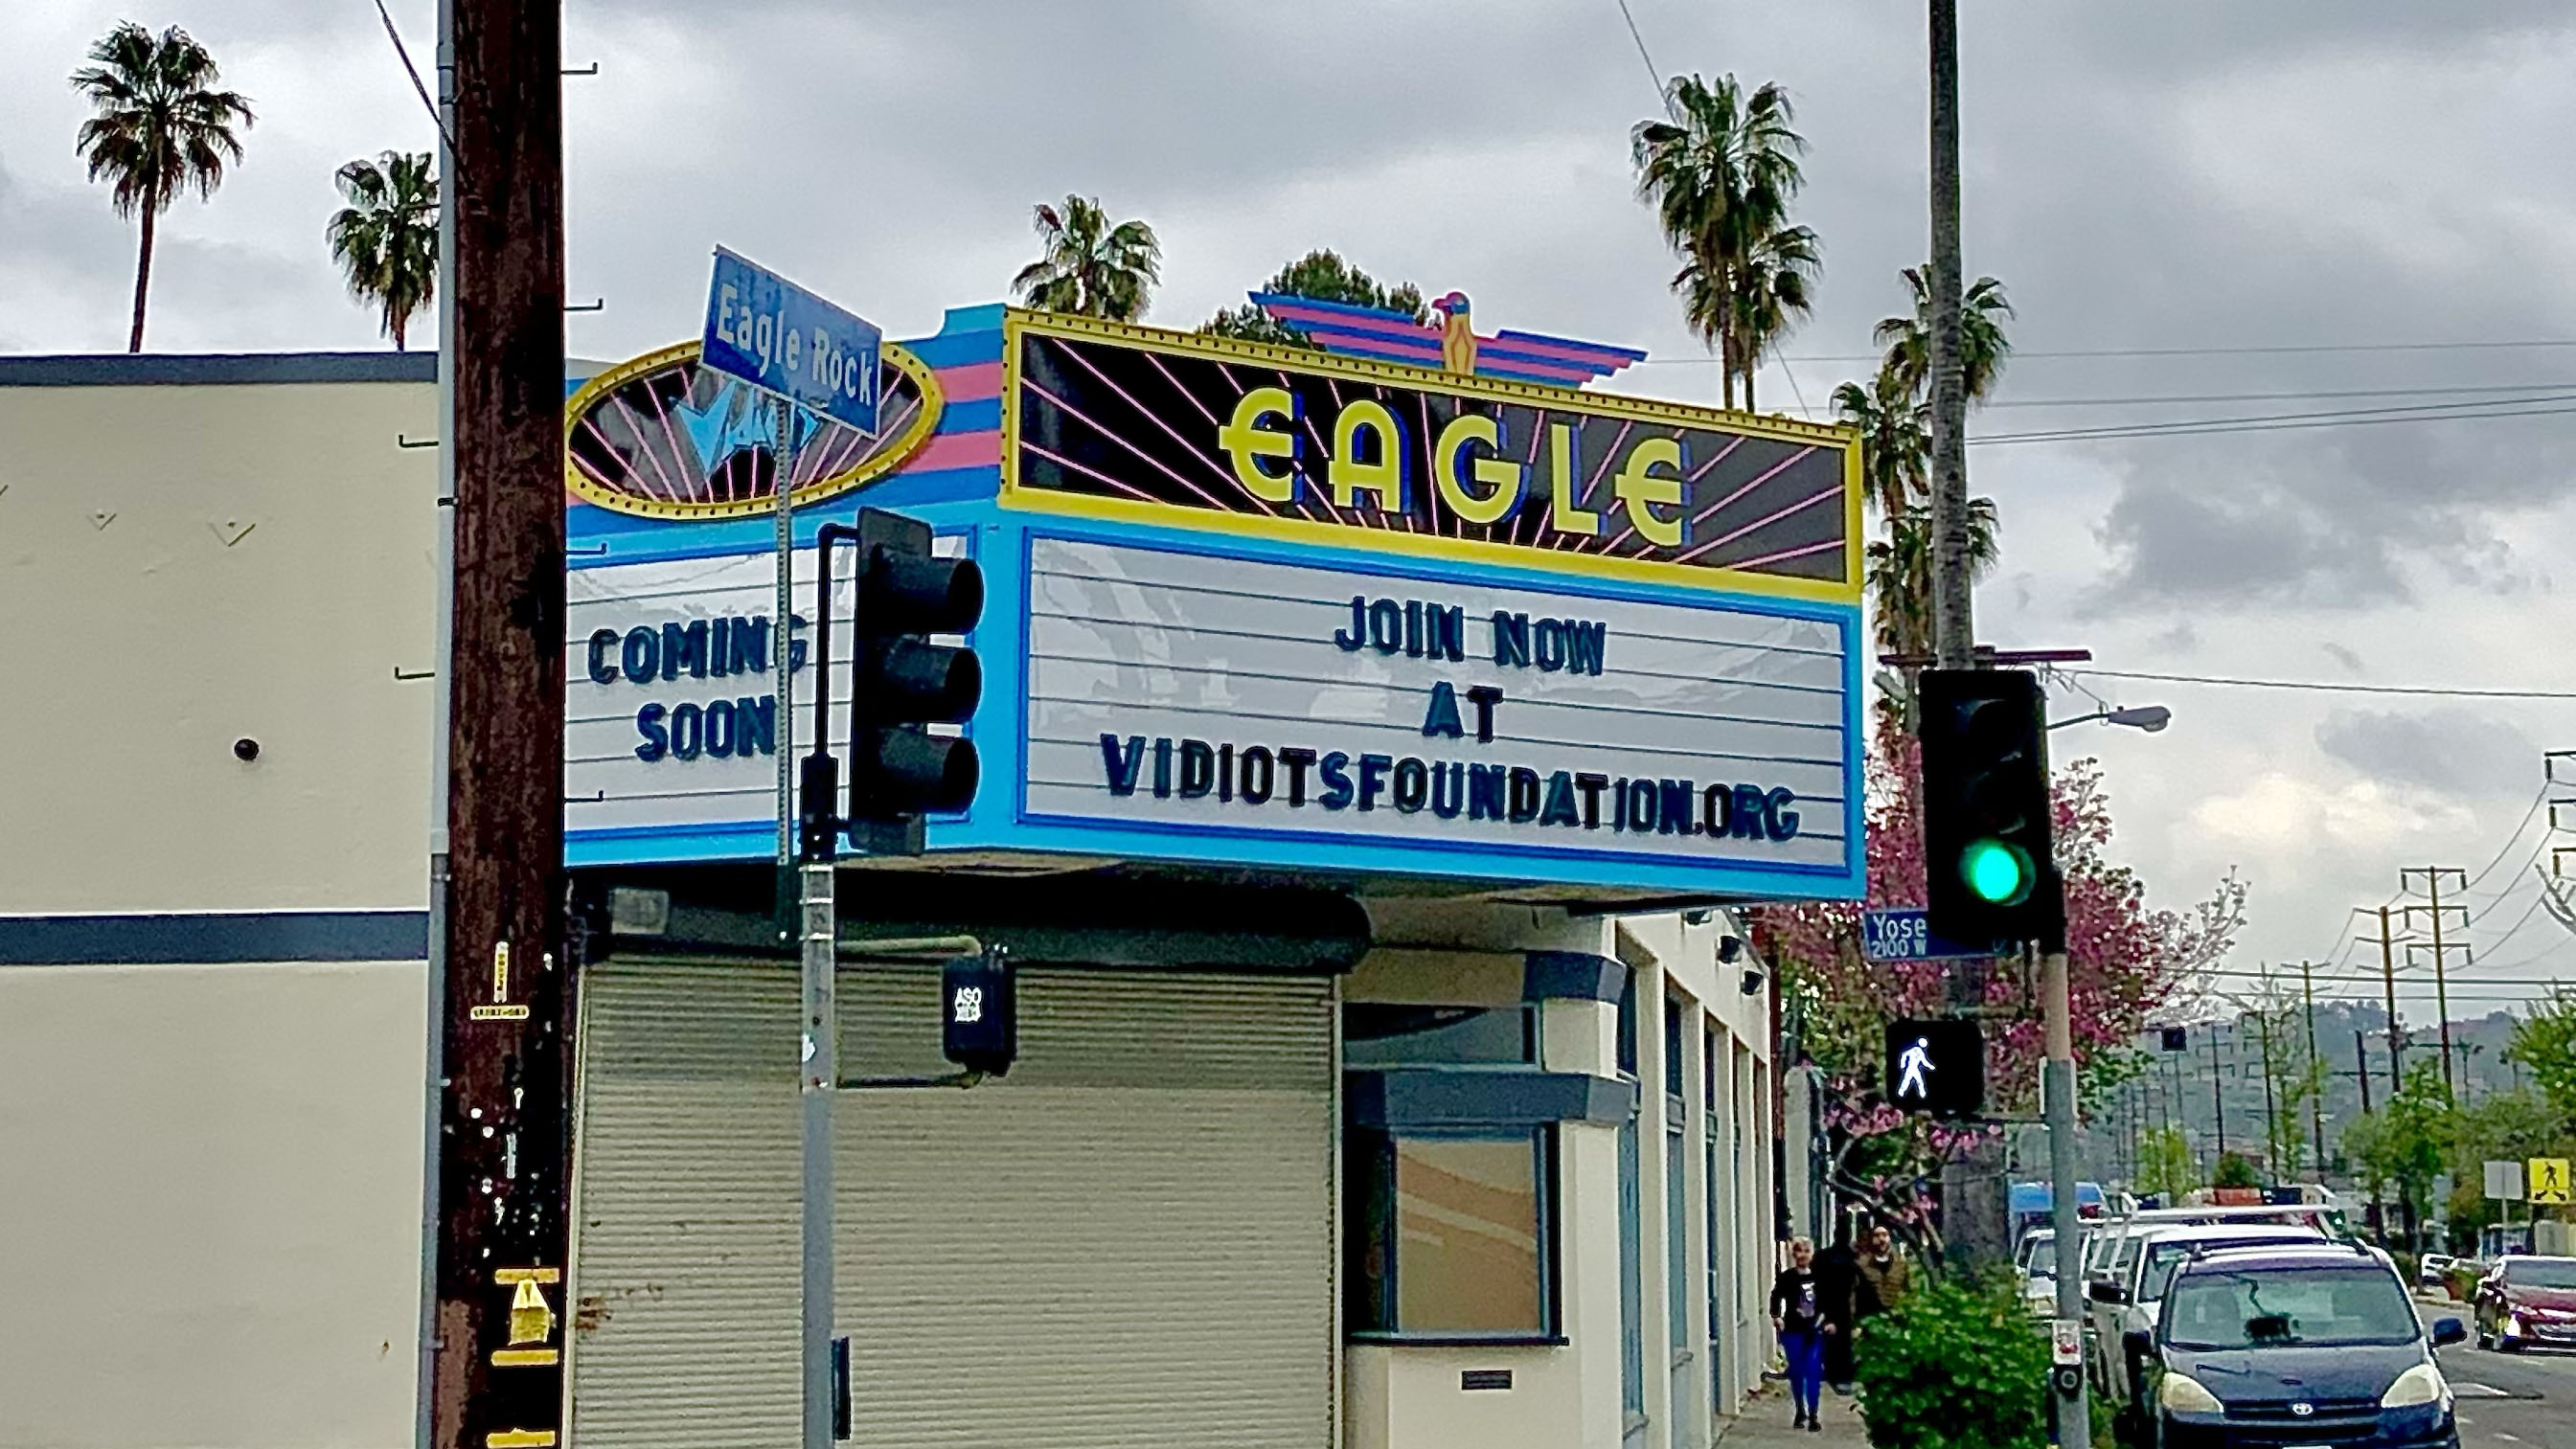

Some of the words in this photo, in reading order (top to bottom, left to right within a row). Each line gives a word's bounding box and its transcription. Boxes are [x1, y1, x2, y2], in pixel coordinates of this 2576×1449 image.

[716, 283, 801, 377] Eagle
[811, 327, 873, 407] Rock
[1219, 386, 1692, 547] EAGLE
[588, 615, 808, 685] COMING
[1334, 596, 1465, 663] JOIN
[1493, 610, 1607, 676] NOW
[634, 694, 777, 762] SOON
[1422, 680, 1504, 743] AT
[1871, 940, 1909, 958] 200
